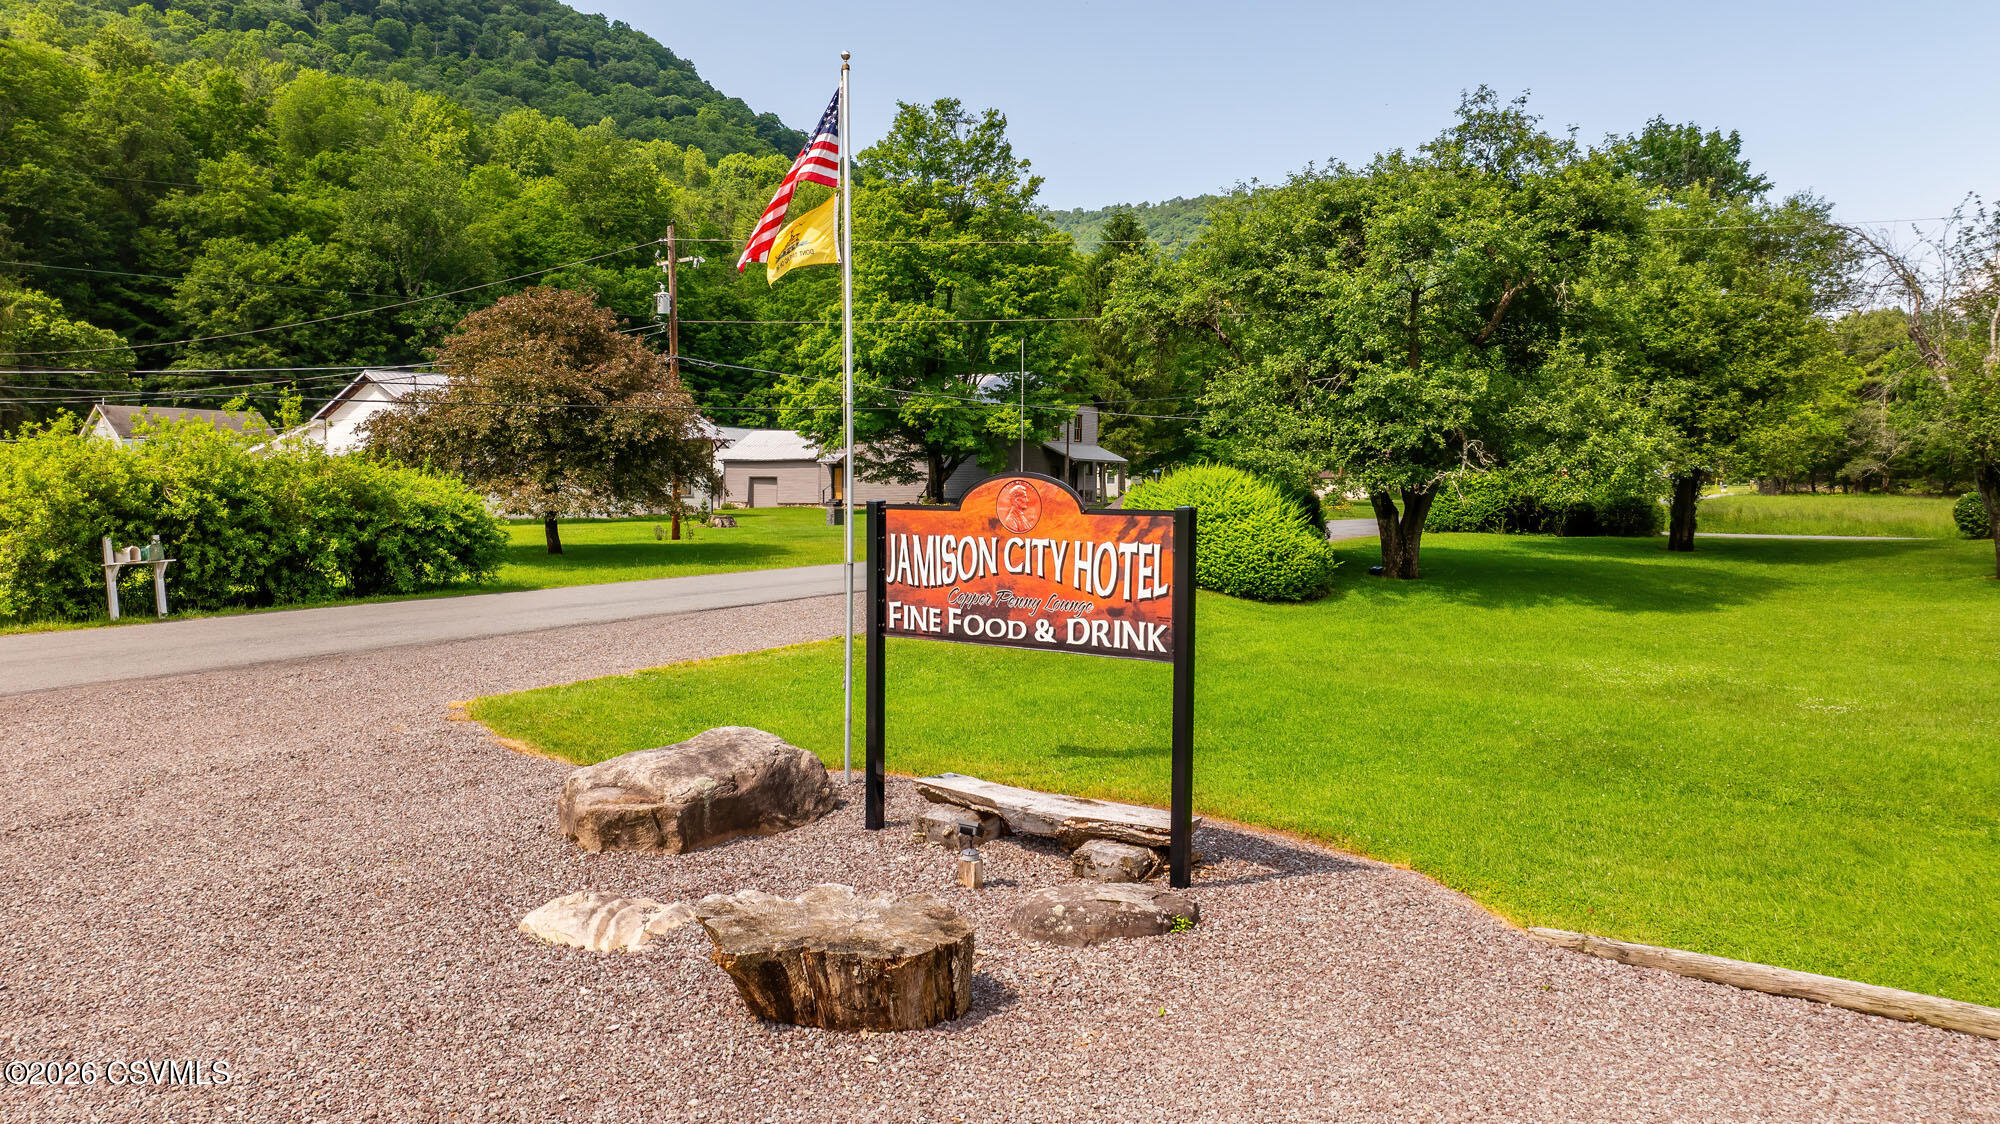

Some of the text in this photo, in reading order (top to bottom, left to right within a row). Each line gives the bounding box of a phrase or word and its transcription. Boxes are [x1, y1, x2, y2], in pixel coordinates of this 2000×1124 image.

[886, 533, 1169, 600] JAMISON CITY HOTEL
[888, 601, 1169, 653] FINE FOOD & DRINK
[947, 587, 1095, 617] Copper Penny Lounge
